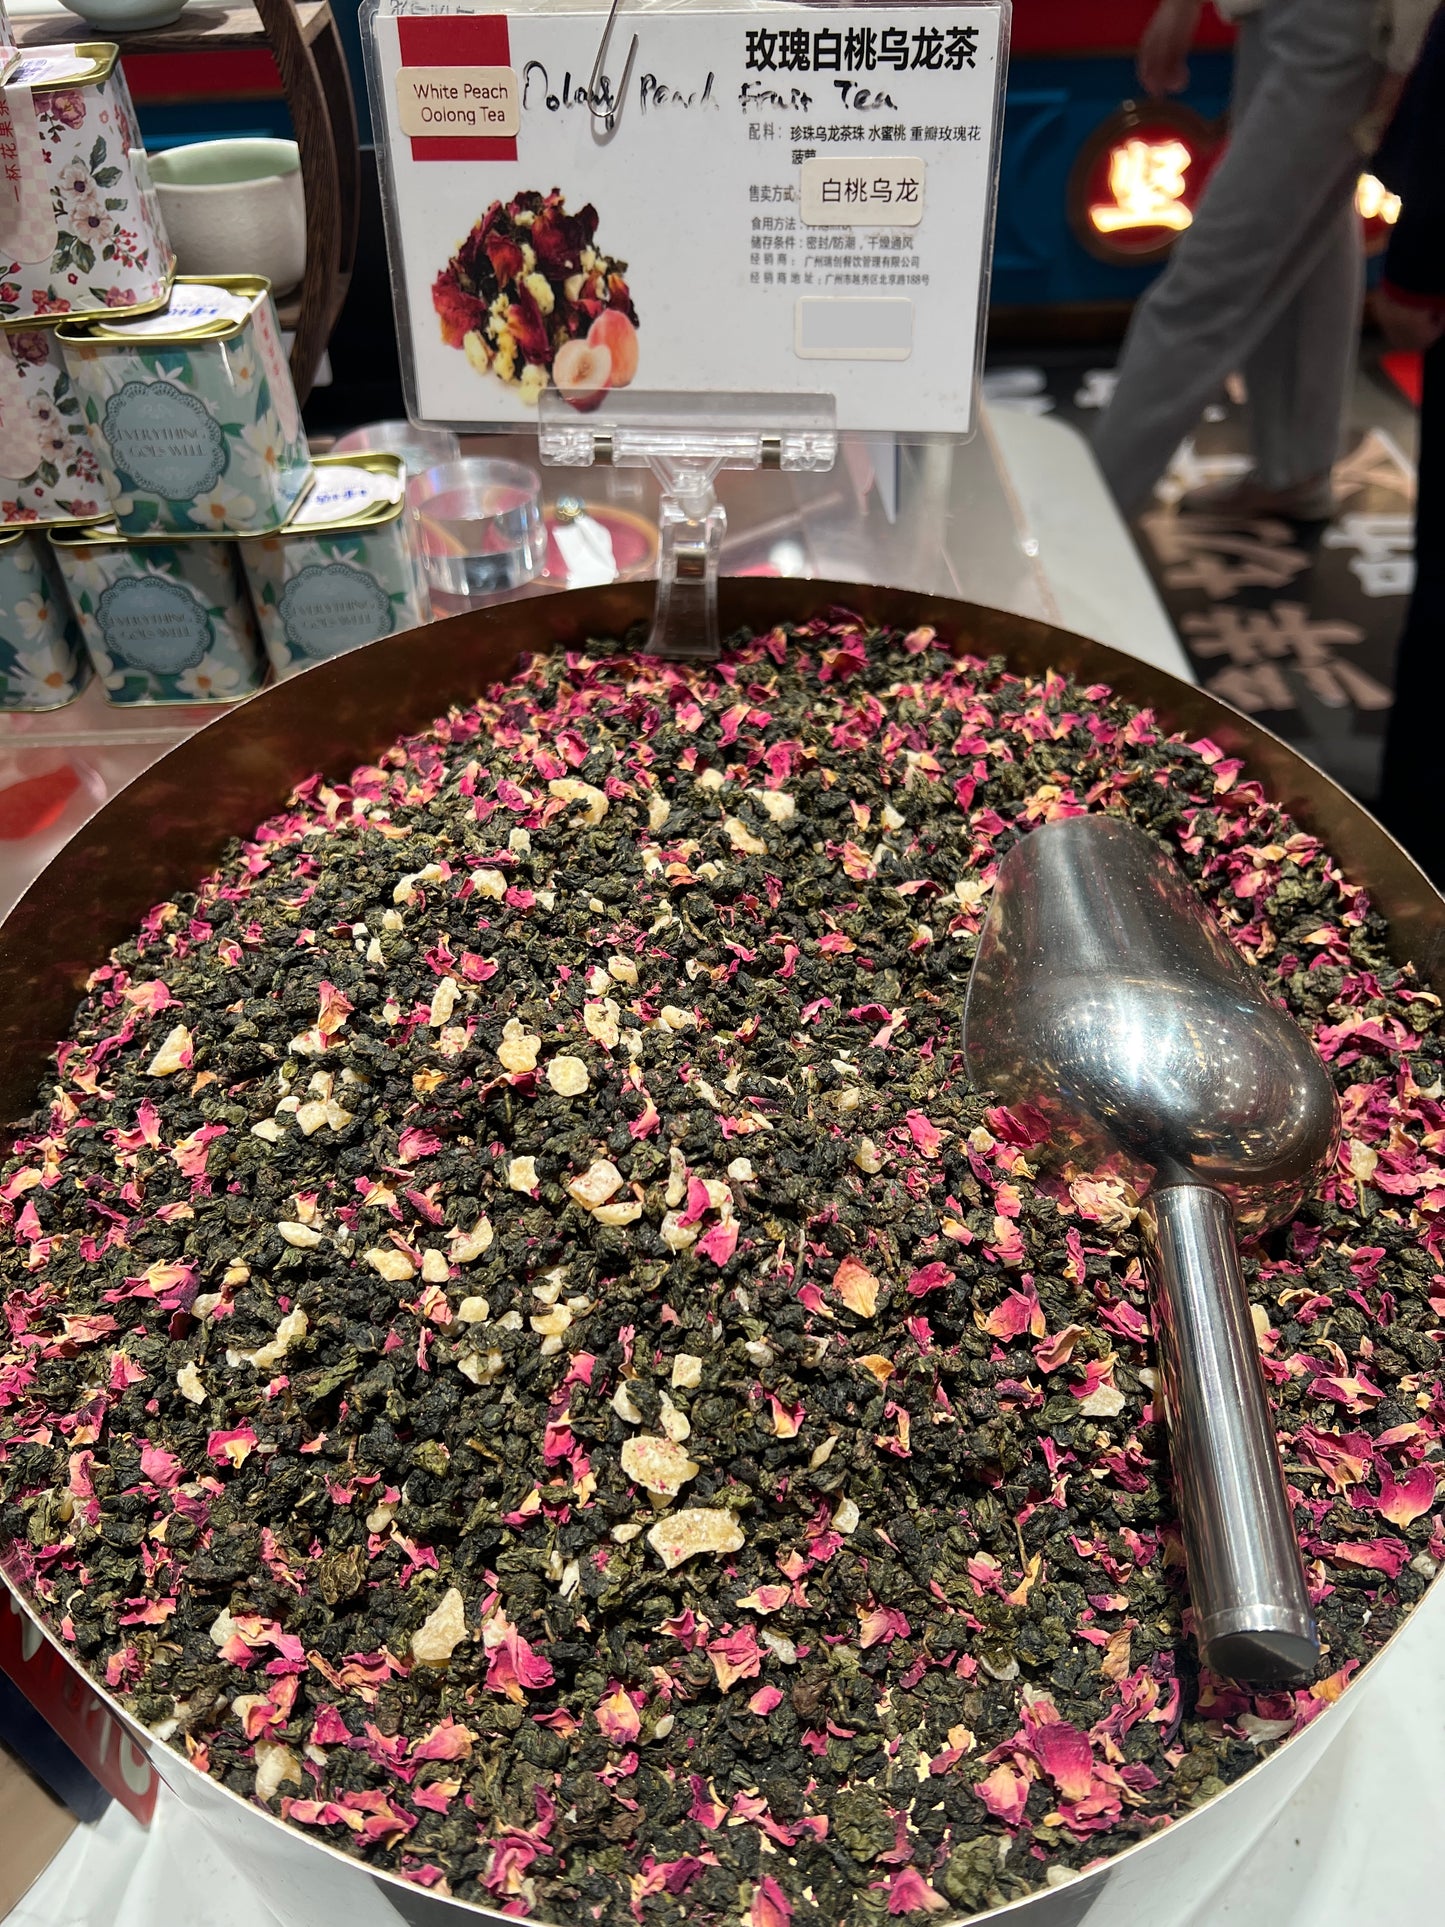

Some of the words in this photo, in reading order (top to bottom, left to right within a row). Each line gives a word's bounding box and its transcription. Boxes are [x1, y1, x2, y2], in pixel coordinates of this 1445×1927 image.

[745, 26, 979, 72] 玫瑰白桃乌龙茶
[413, 83, 458, 99] White
[463, 83, 508, 99] Peach
[834, 80, 898, 110] Tea
[421, 107, 476, 125] Oolong
[480, 107, 505, 122] Tea
[790, 125, 865, 142] 珍珠乌龙茶珠
[868, 125, 906, 142] 水蜜桃
[910, 125, 981, 142] 重瓣玫瑰花
[822, 177, 919, 204] 白桃乌龙
[117, 428, 207, 441] EVERYTHING
[168, 444, 207, 457] WELL
